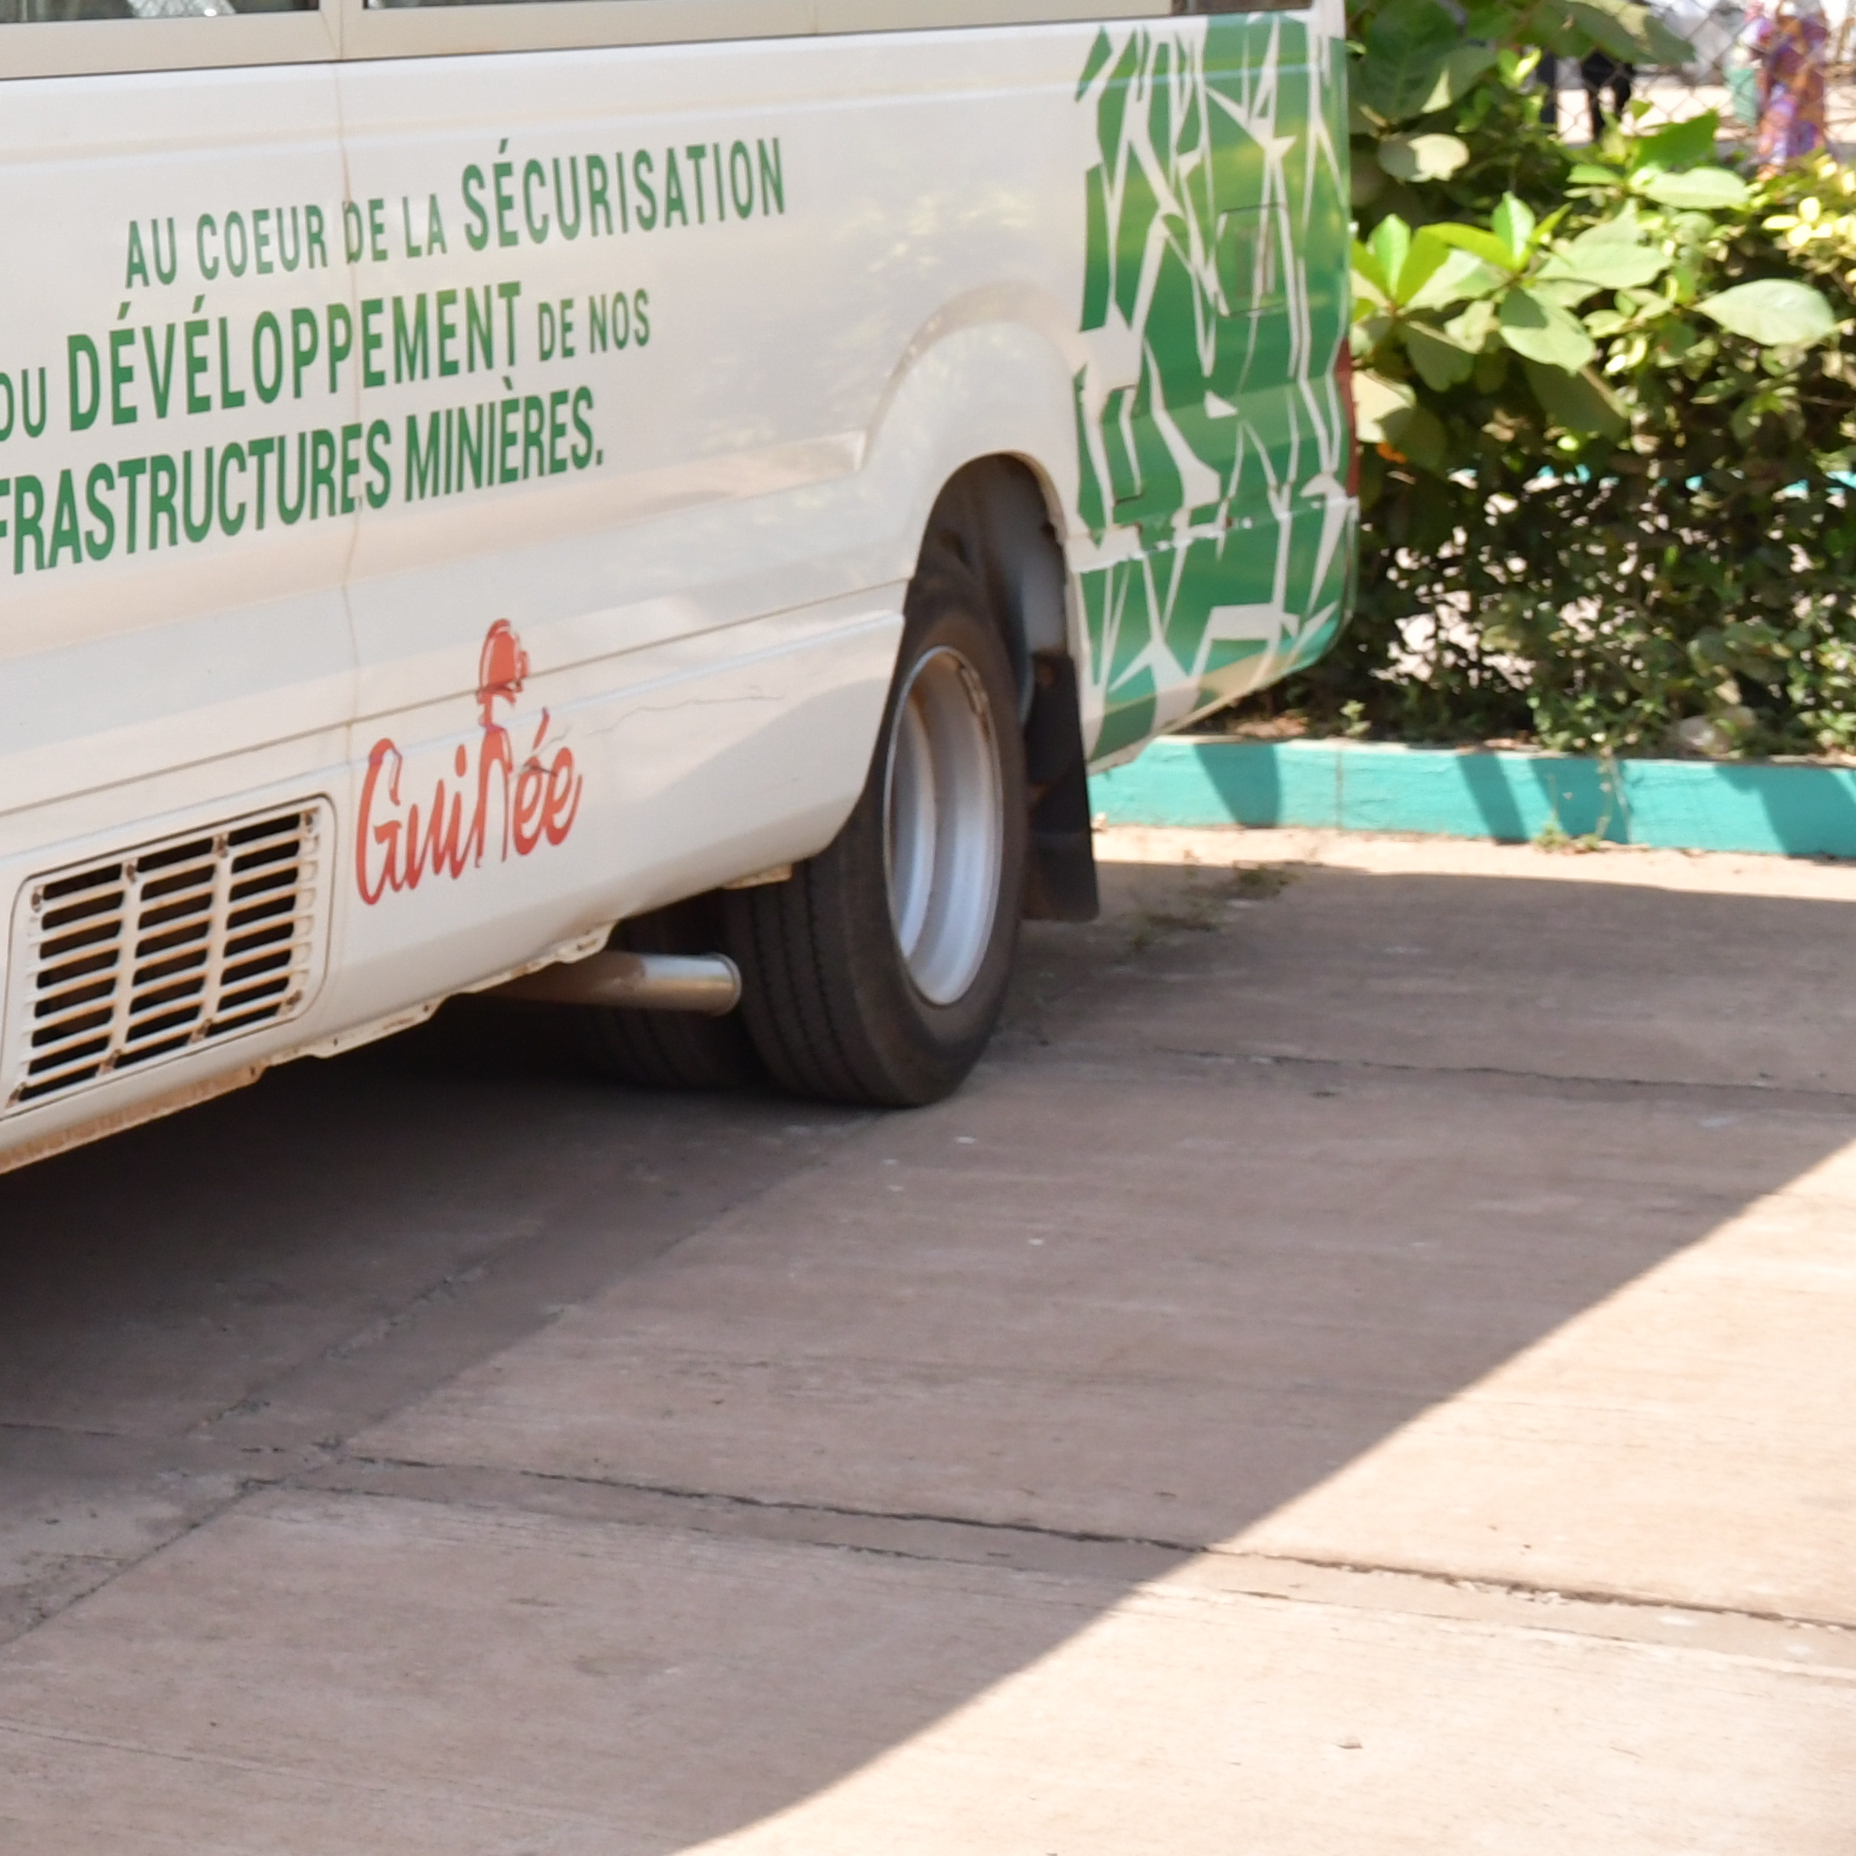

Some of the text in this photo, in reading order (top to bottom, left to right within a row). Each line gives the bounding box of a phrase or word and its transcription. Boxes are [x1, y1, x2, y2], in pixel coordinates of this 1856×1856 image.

[125, 137, 787, 289] AU COEUR DE LA SÉCURISATION
[67, 281, 521, 432] DÉVÉLOPPEMENT
[537, 298, 576, 362] DE
[588, 288, 652, 356] NOS
[405, 381, 605, 502] MINIÈRES.
[355, 707, 584, 906] Guinée
